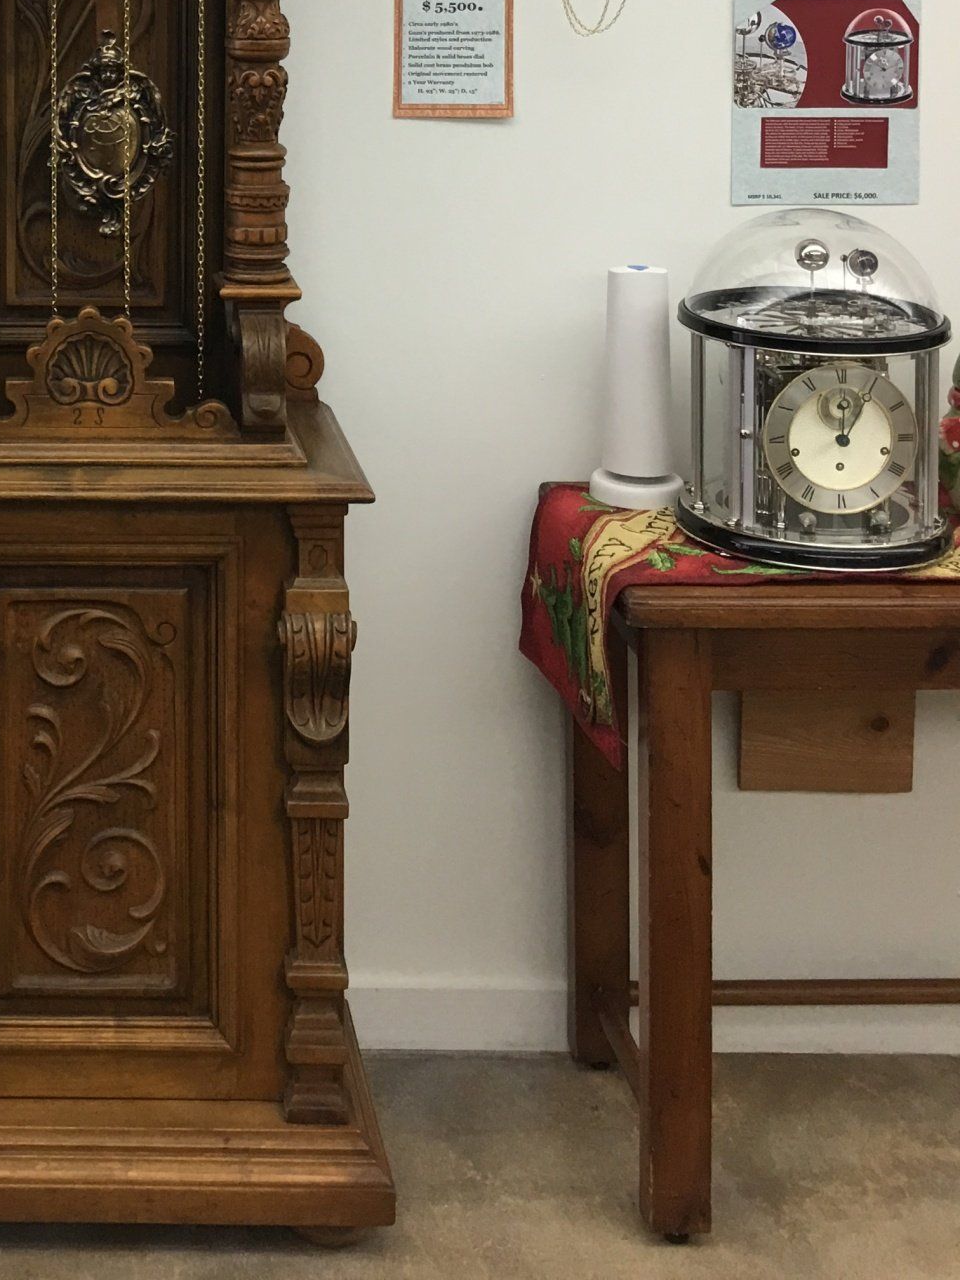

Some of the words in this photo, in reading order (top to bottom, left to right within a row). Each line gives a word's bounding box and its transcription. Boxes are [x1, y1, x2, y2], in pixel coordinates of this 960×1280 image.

[422, 0, 430, 12] $
[434, 2, 483, 13] 5,500.
[854, 192, 878, 200] $6,000.
